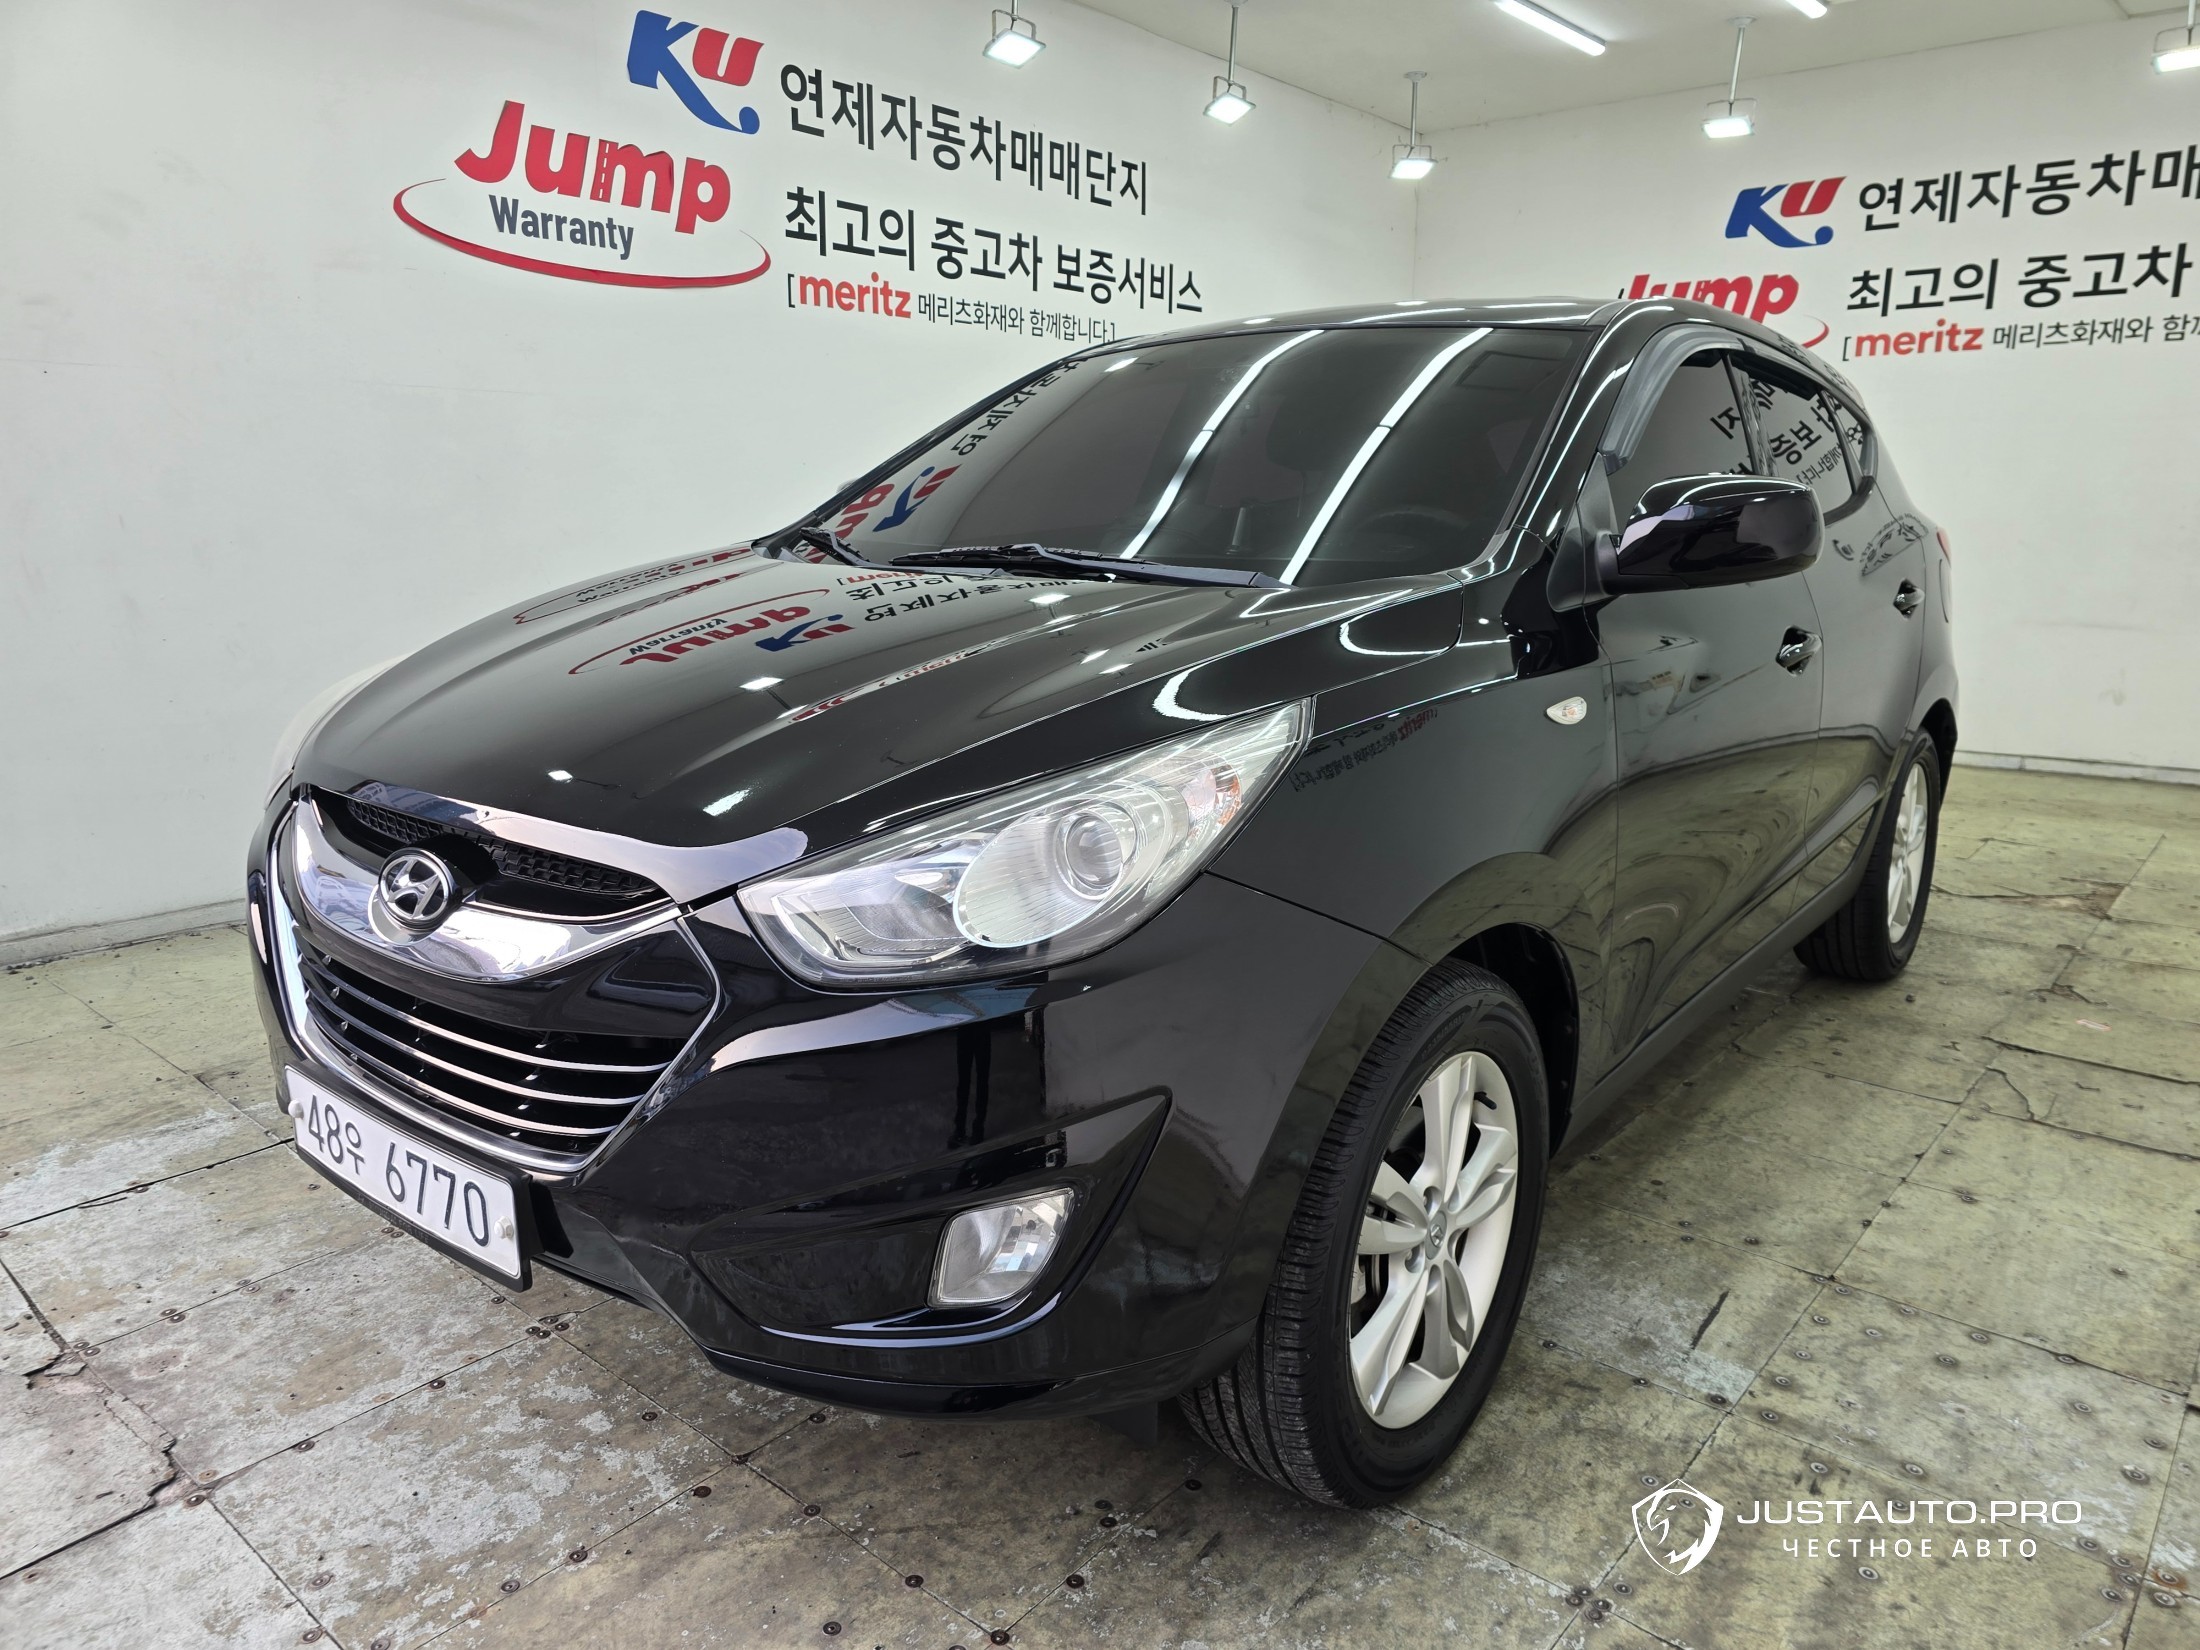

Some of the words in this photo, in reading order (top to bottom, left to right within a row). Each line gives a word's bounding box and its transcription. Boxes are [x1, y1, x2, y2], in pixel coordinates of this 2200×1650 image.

[454, 100, 731, 235] Jump
[779, 64, 1147, 216] 연제자동차매매단지
[488, 194, 634, 261] Warranty
[784, 185, 916, 272] 최고의
[930, 216, 1043, 292] 중고차
[1053, 244, 1203, 314] 보증서비스
[918, 293, 1025, 335] 메리츠화재와
[1846, 258, 2000, 318] 최고의
[2017, 242, 2193, 308] 중고차
[1992, 315, 2154, 350] 메리츠화재와
[307, 1094, 366, 1176] 48우
[385, 1141, 490, 1247] 6770
